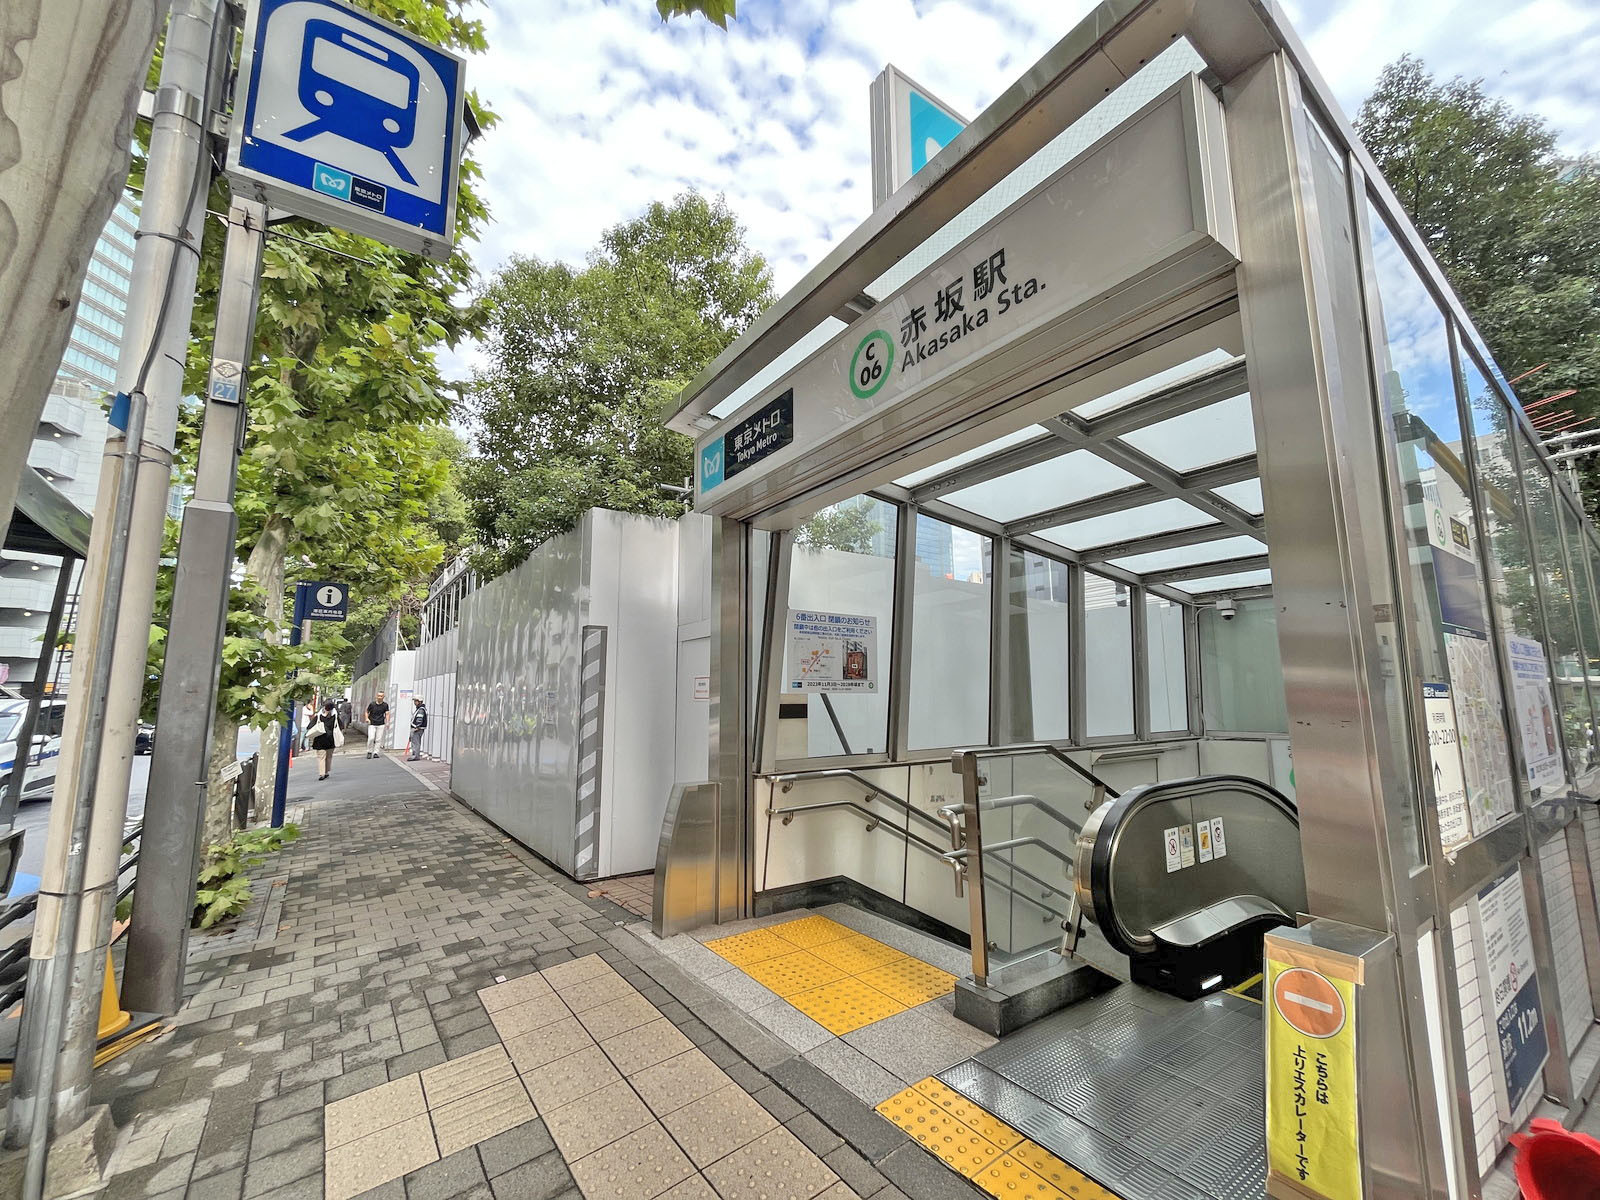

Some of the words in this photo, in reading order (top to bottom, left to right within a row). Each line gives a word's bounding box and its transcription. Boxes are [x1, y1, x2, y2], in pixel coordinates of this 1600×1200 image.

[900, 248, 1007, 347] 赤坂駅
[901, 308, 989, 372] Akasaka
[997, 278, 1047, 315] Sta.
[865, 343, 875, 360] C
[214, 383, 235, 399] 27
[860, 360, 882, 386] 06
[734, 409, 780, 452] 東京メトロ
[737, 446, 756, 463] Tokyo
[756, 432, 778, 452] Metro
[1315, 1052, 1329, 1105] こちらは
